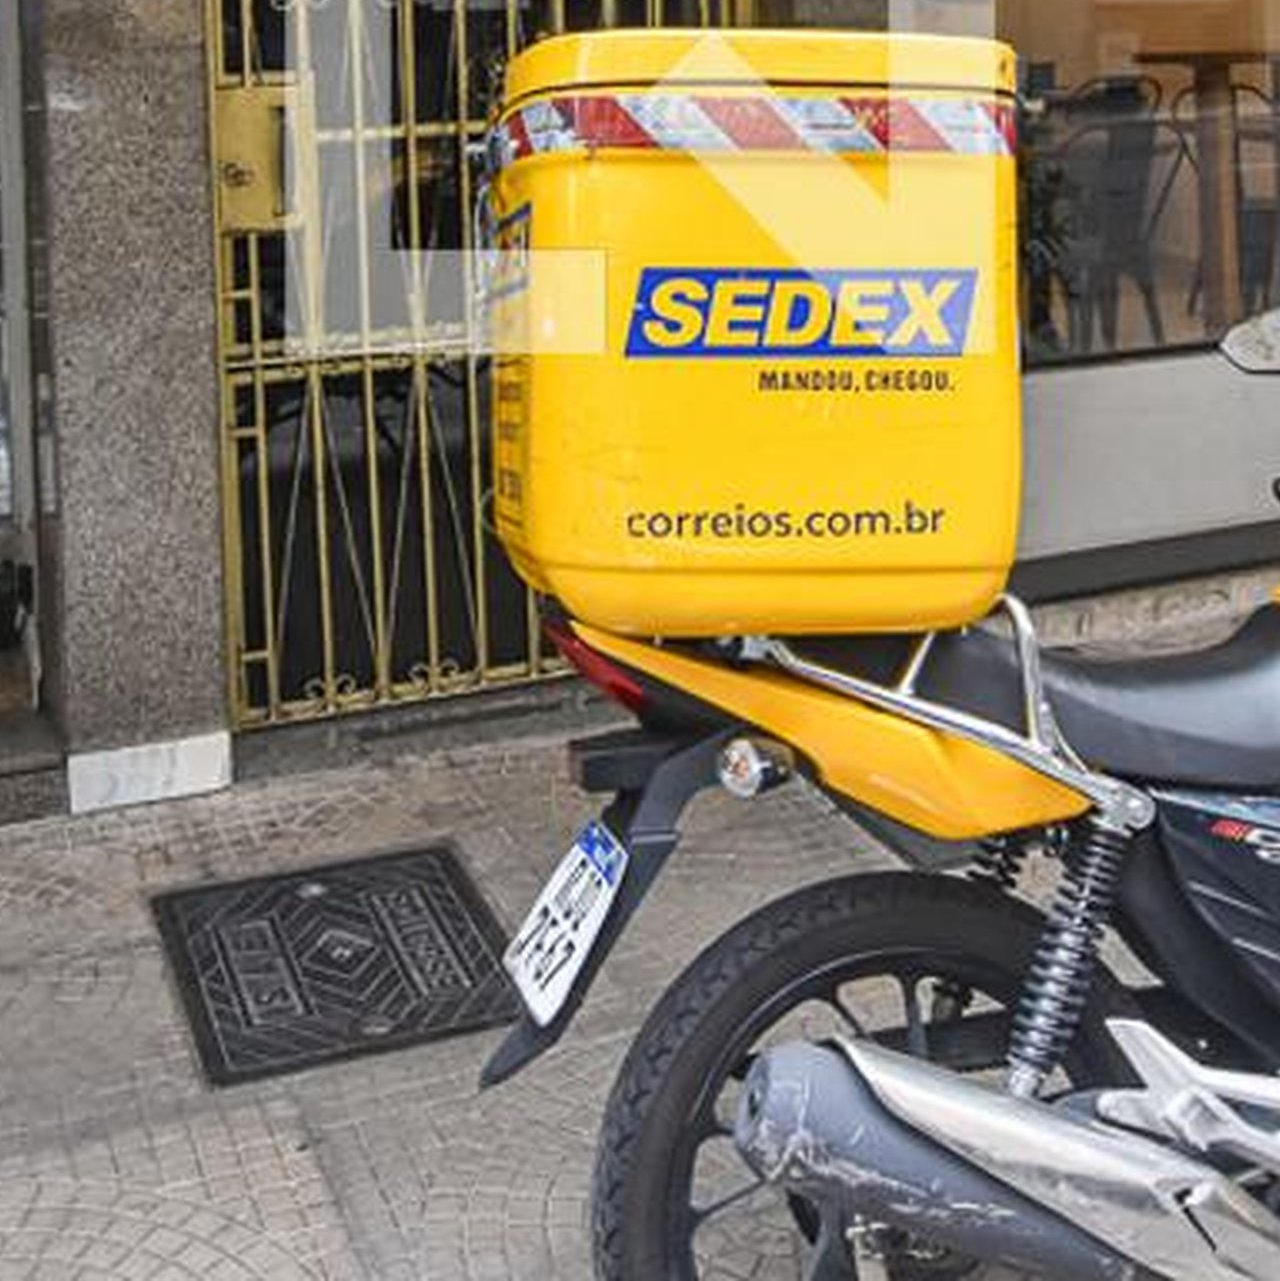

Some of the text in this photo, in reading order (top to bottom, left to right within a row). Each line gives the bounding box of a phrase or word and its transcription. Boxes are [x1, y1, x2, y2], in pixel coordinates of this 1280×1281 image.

[641, 277, 961, 348] SEDEX
[757, 369, 955, 394] MANDOU, CHEGOU.
[626, 501, 946, 538] correios.com.br
